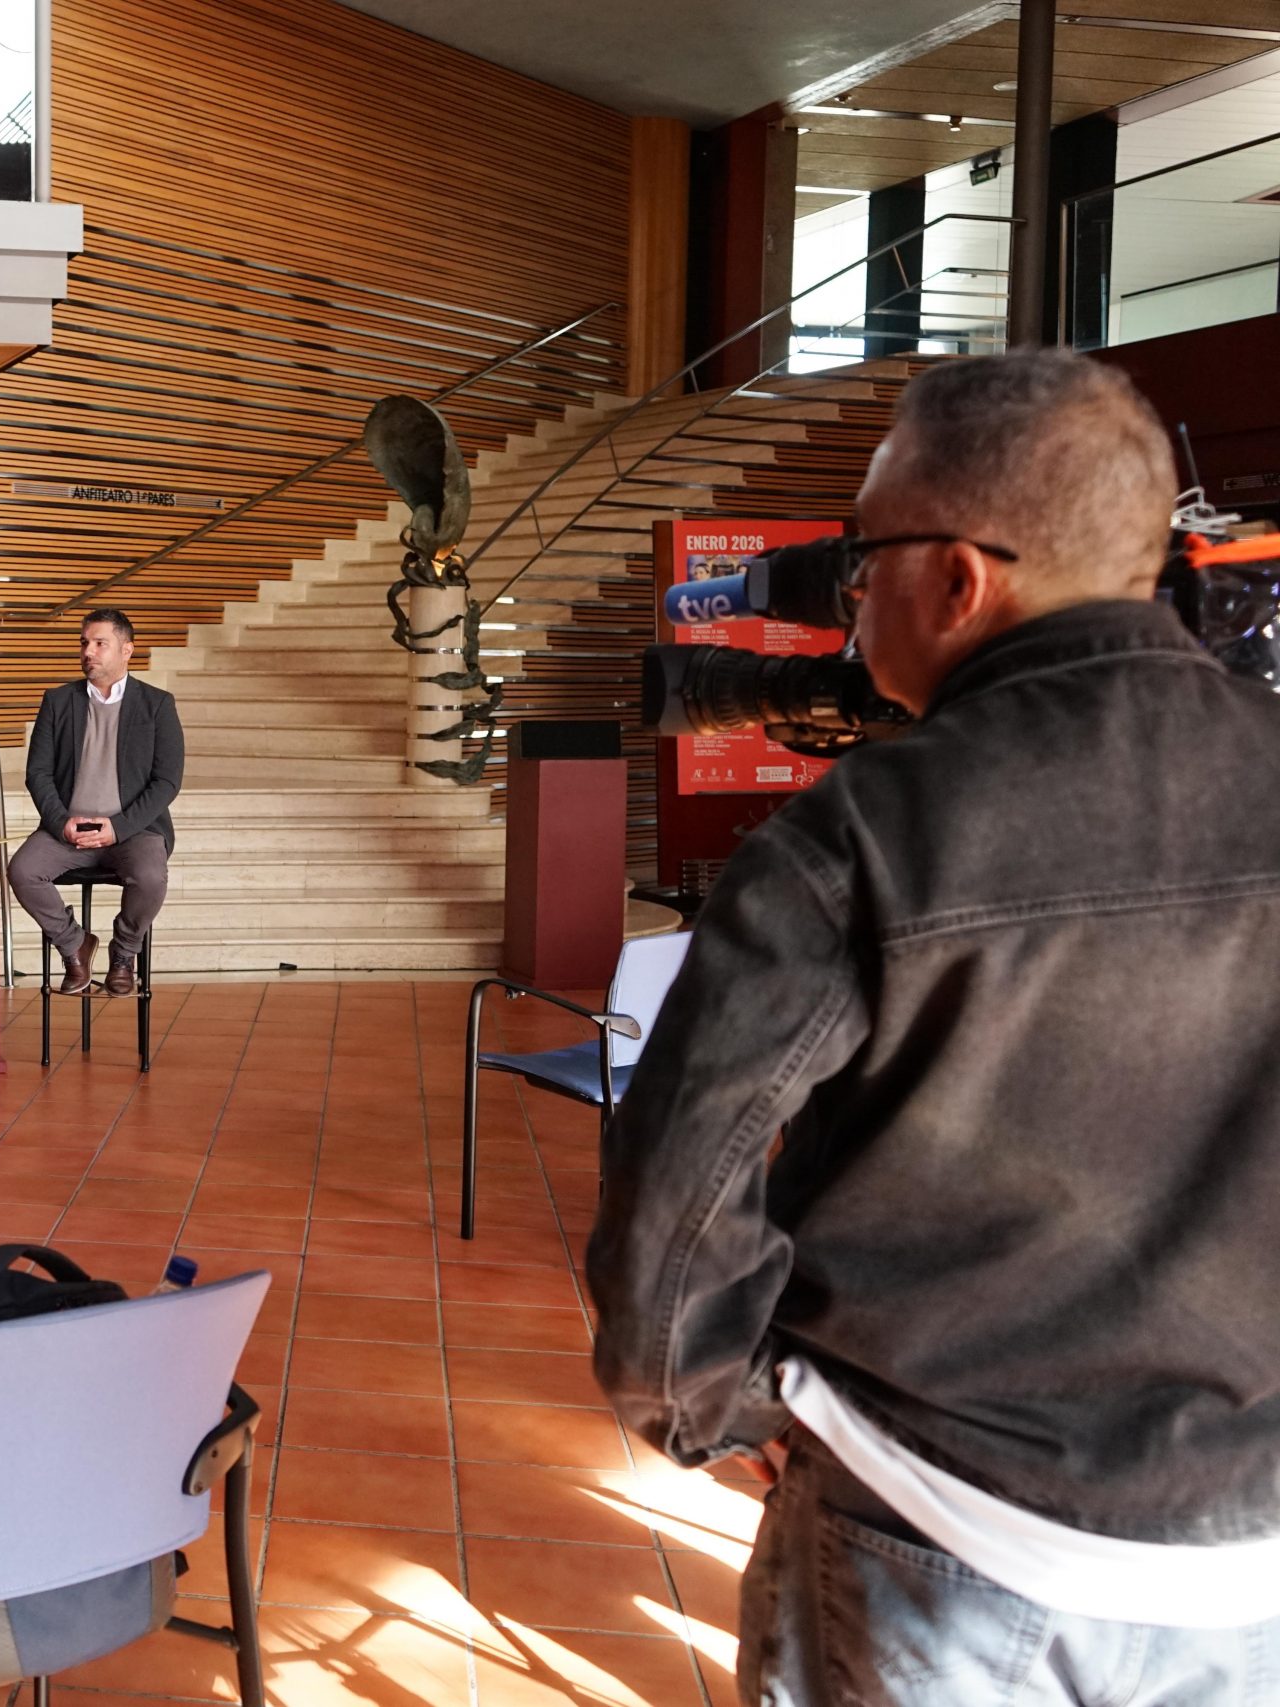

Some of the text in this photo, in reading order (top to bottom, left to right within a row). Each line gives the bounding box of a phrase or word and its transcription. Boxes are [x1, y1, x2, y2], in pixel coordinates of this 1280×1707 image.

[72, 486, 133, 504] ANFITEATRO
[147, 491, 175, 506] PARES
[686, 535, 764, 550] ENERO 2026
[677, 594, 737, 623] tve
